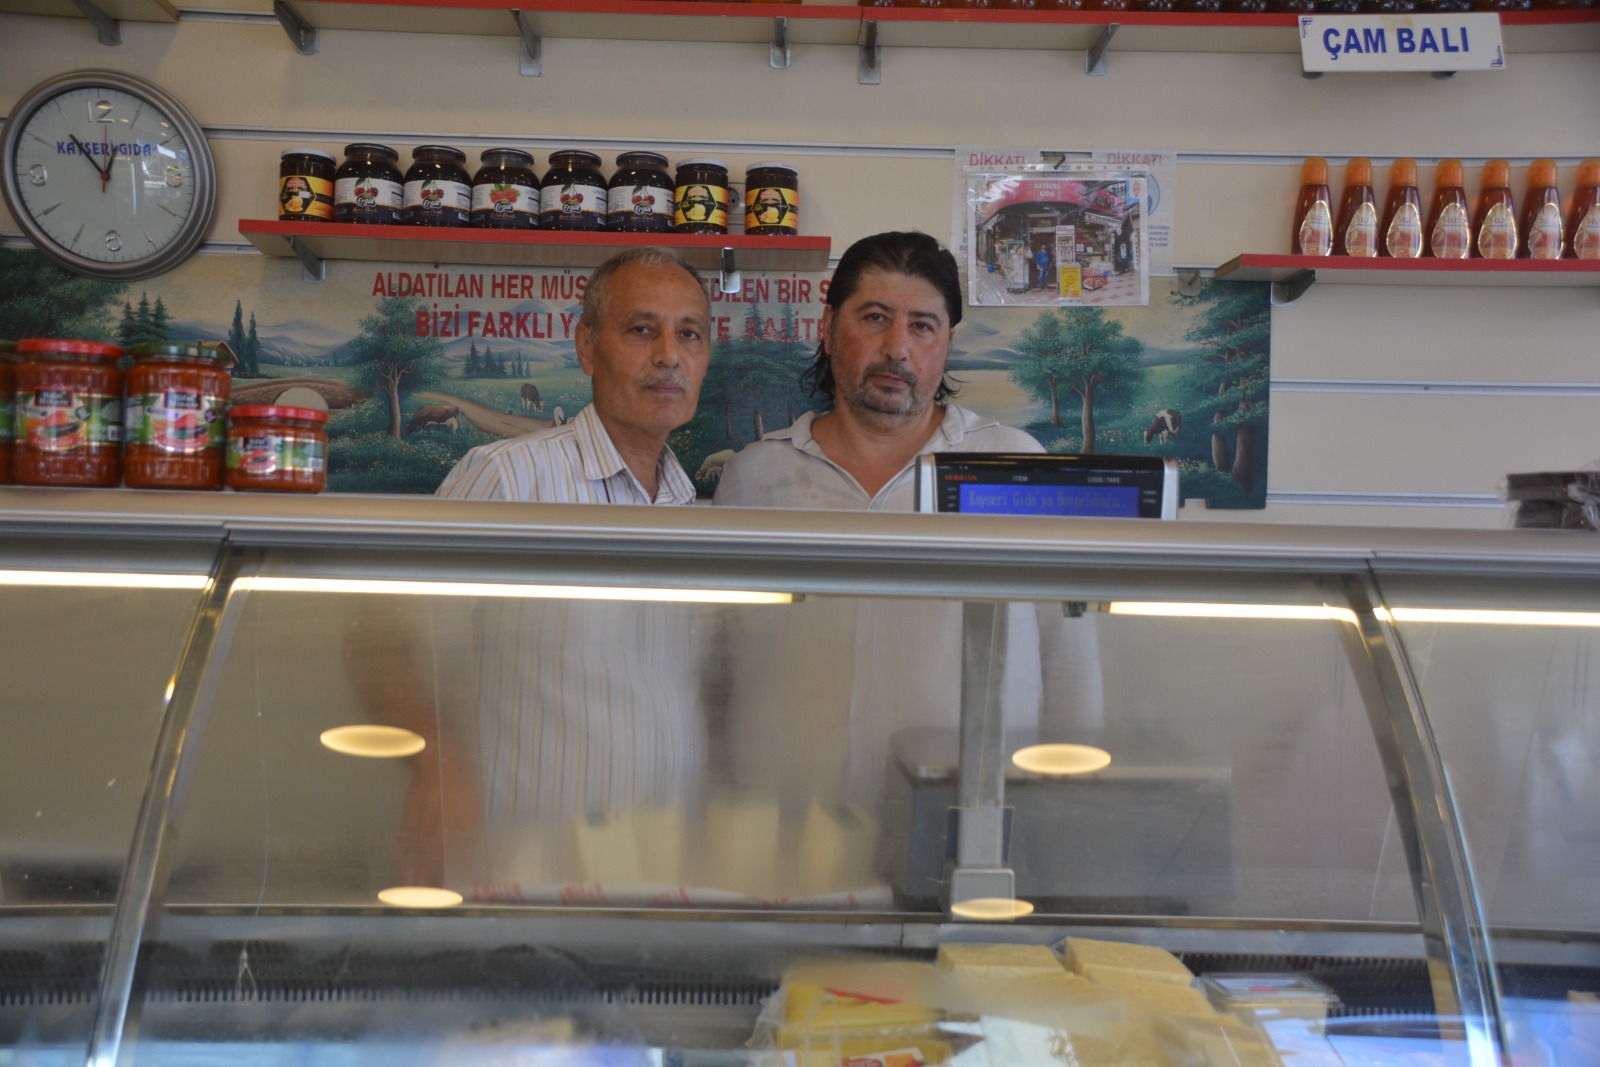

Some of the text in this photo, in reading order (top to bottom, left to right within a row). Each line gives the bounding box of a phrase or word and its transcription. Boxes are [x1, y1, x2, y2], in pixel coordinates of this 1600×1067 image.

[1322, 27, 1470, 60] ÇAM BALI
[88, 100, 115, 123] 12
[119, 143, 151, 157] GIDA
[372, 272, 484, 298] ALDATILAN
[491, 274, 534, 299] HER
[777, 273, 812, 303] BİR
[415, 303, 460, 337] BİZİ
[467, 311, 553, 338] FARKLI
